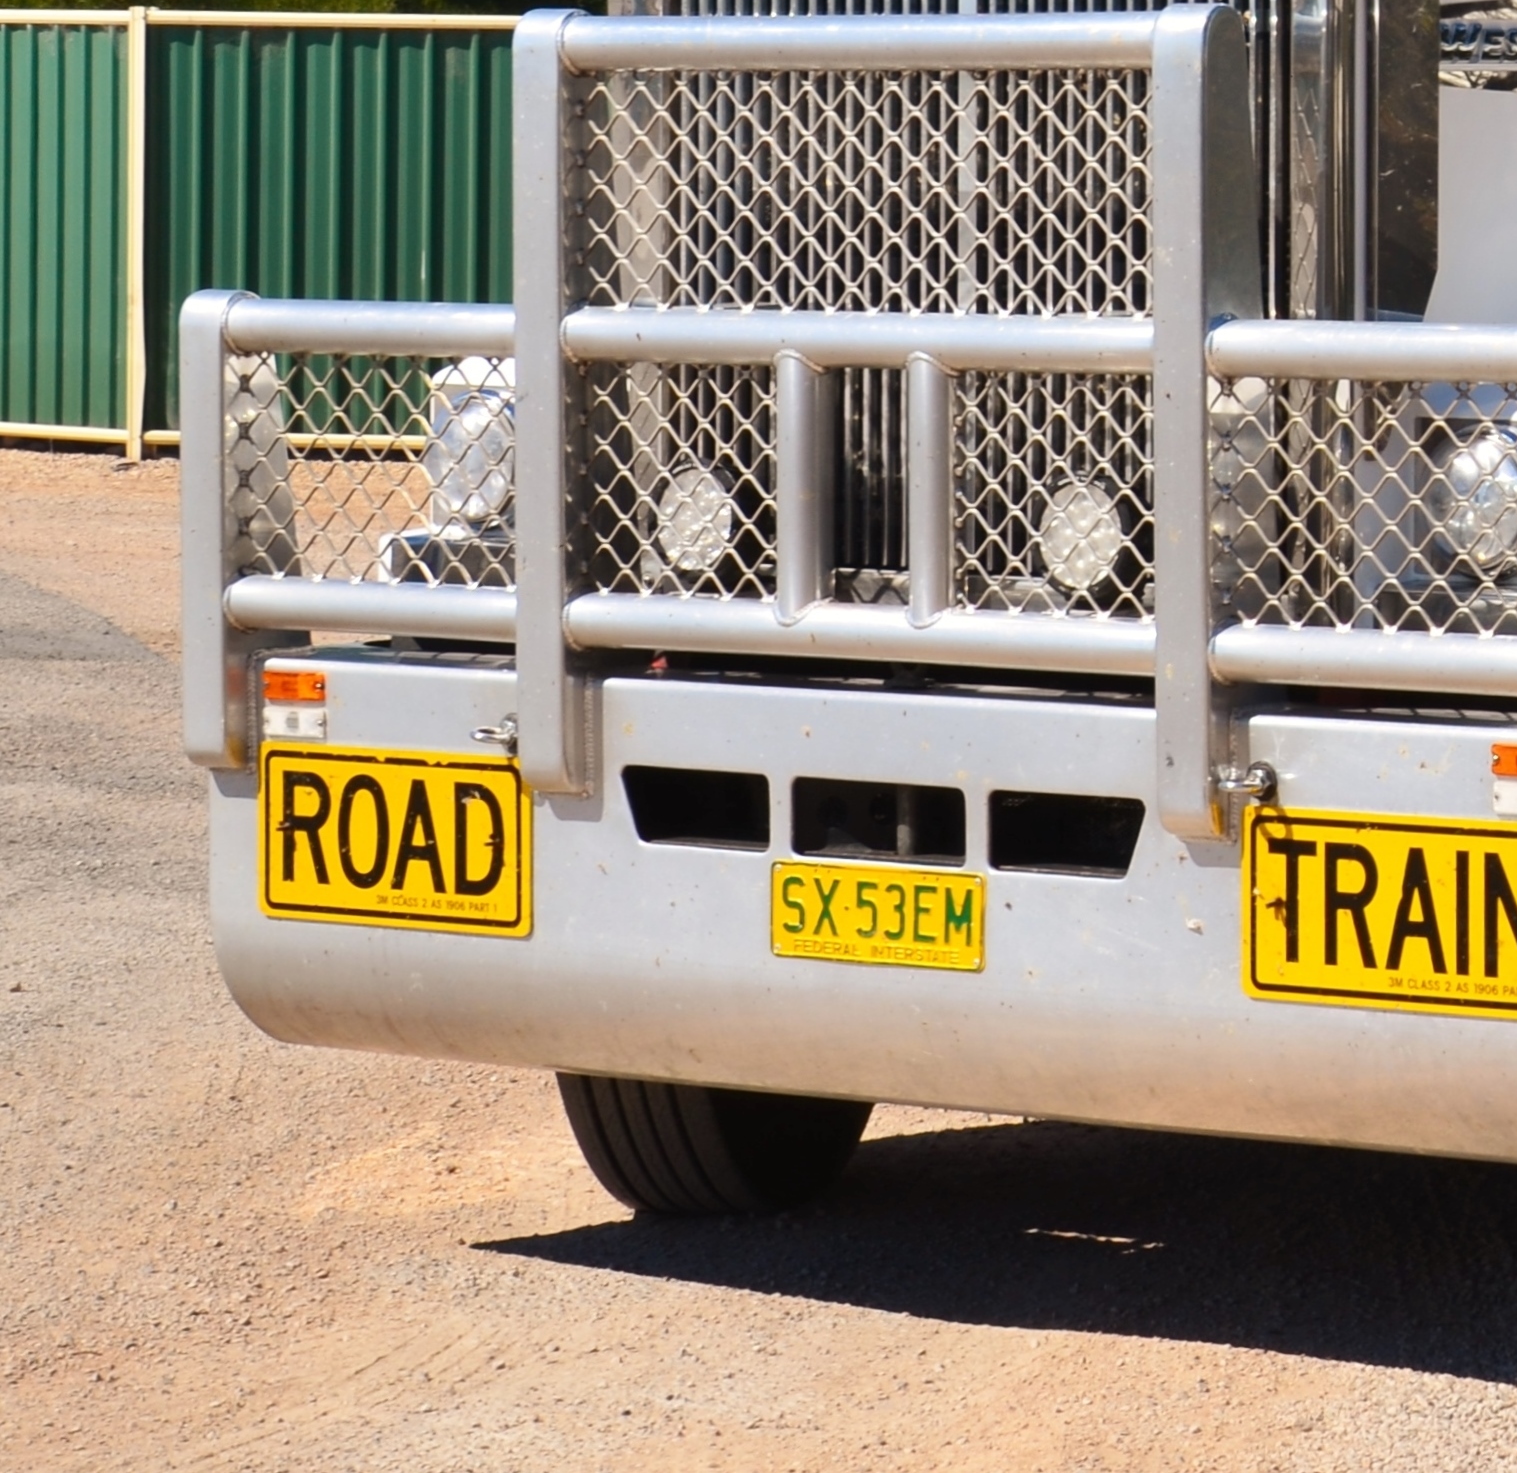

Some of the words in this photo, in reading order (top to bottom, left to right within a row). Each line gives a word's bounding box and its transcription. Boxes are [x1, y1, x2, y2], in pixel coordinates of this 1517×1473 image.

[282, 770, 505, 896] ROAD
[422, 898, 428, 909] 2
[431, 899, 442, 909] AS
[446, 900, 466, 912] 1906
[469, 902, 490, 913] PART
[794, 938, 862, 956] FEDERAL
[871, 945, 960, 965] INTERSTATE
[1388, 977, 1403, 988] 3M
[1407, 978, 1441, 991] CLASS
[1445, 981, 1451, 992] 2
[1456, 982, 1469, 994] AS
[1474, 983, 1499, 995] 1906
